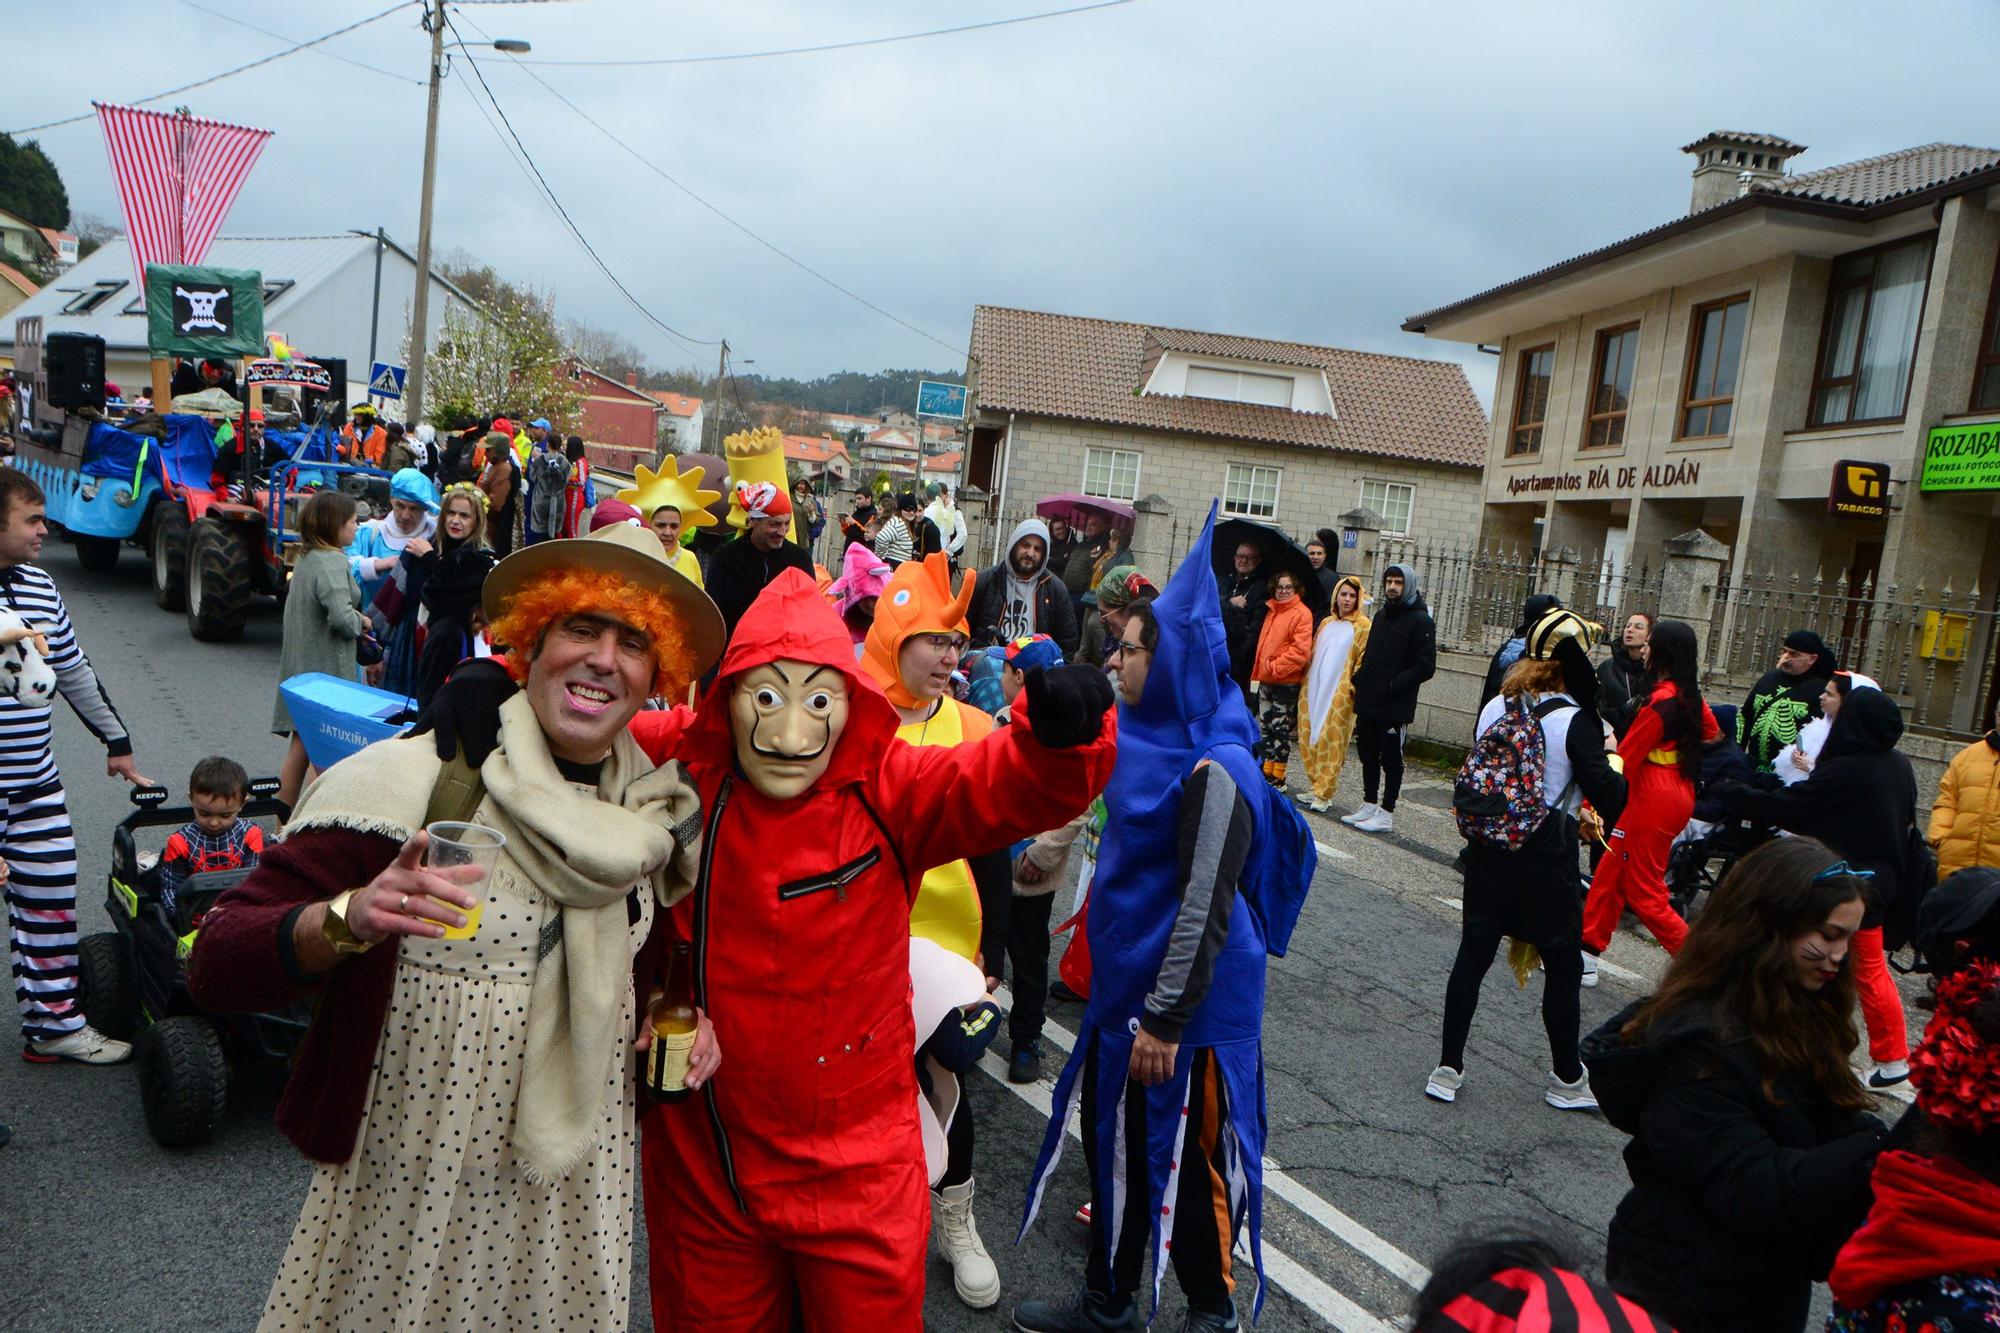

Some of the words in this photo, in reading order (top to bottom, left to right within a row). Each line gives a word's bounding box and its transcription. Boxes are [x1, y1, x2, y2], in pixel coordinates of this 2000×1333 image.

[1507, 472, 1582, 496] Apartamentos
[1588, 464, 1610, 489] RÍA
[1616, 467, 1638, 489] DE
[1643, 458, 1701, 487] ALDÁN
[1925, 476, 1966, 486] CHUCHES
[1836, 503, 1883, 515] TABACOS
[320, 723, 369, 746] JATUXIÑA
[252, 782, 280, 791] KEEPRA
[136, 792, 166, 800] KEEPRA
